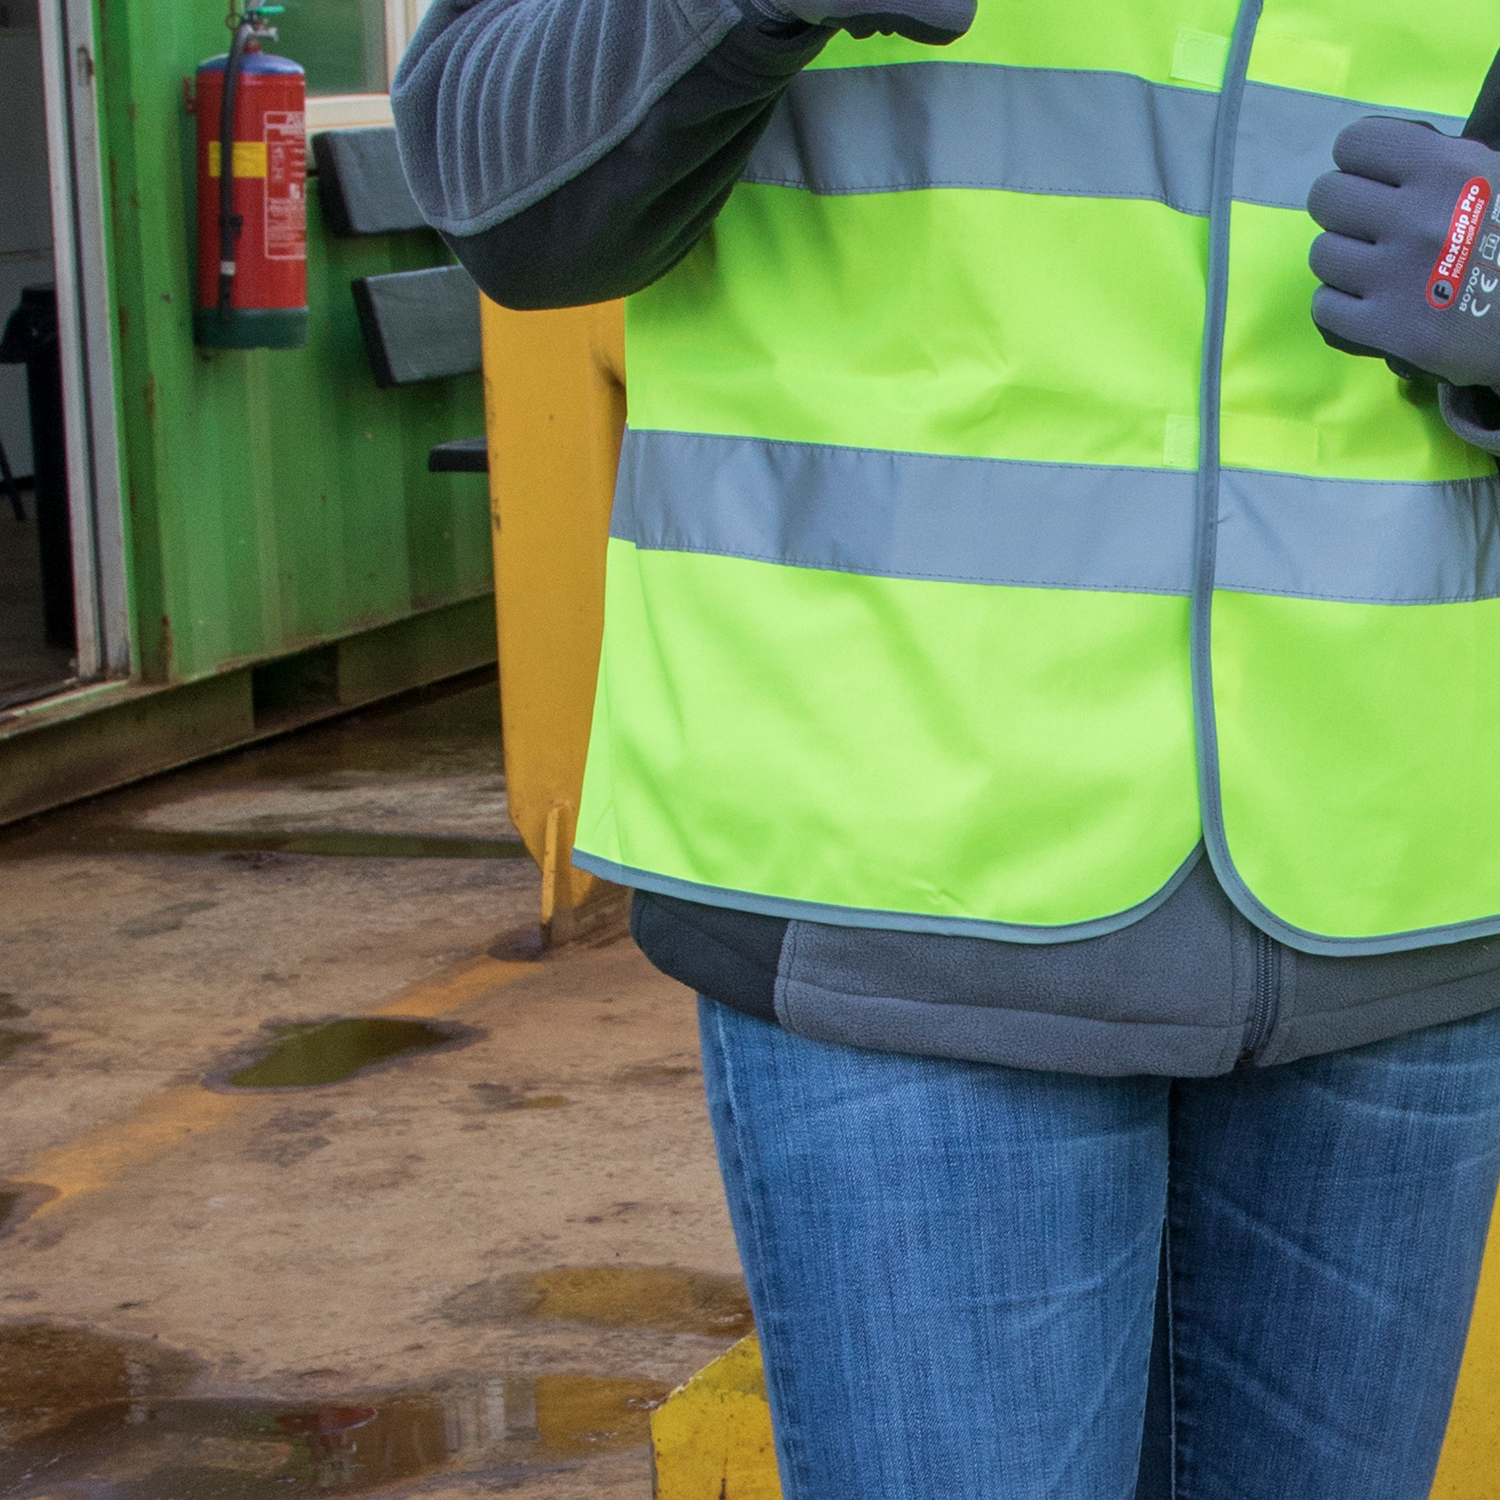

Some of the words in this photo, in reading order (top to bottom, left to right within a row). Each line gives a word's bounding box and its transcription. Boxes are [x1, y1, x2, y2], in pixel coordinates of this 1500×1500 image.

[1438, 214, 1470, 277] FlexGrip
[1461, 185, 1480, 212] Pro
[1451, 246, 1469, 278] PROTECT
[1465, 225, 1476, 245] YOUR
[1471, 198, 1485, 225] HANDS
[1471, 273, 1499, 317] CE
